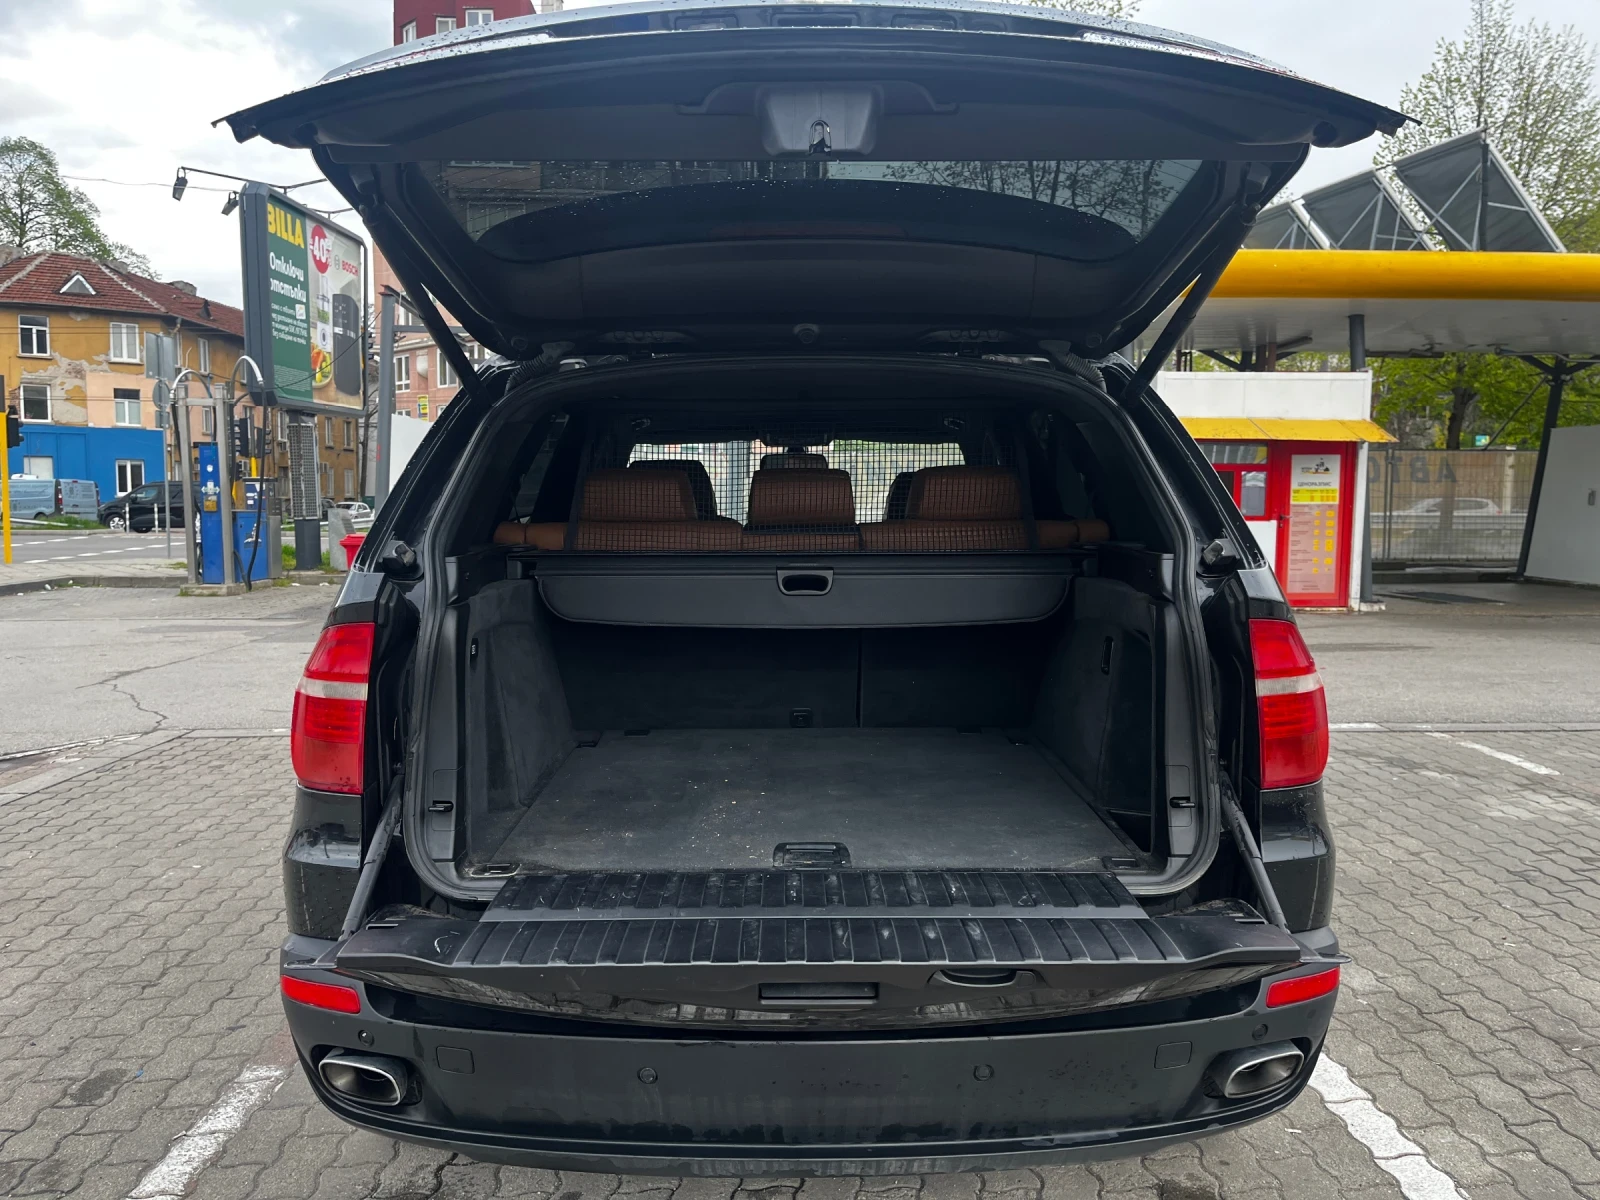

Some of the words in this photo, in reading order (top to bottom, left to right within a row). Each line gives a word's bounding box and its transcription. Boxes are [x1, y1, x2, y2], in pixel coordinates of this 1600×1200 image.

[267, 203, 305, 249] BILLA
[269, 251, 304, 281] Отключи
[341, 260, 359, 277] BOSCH
